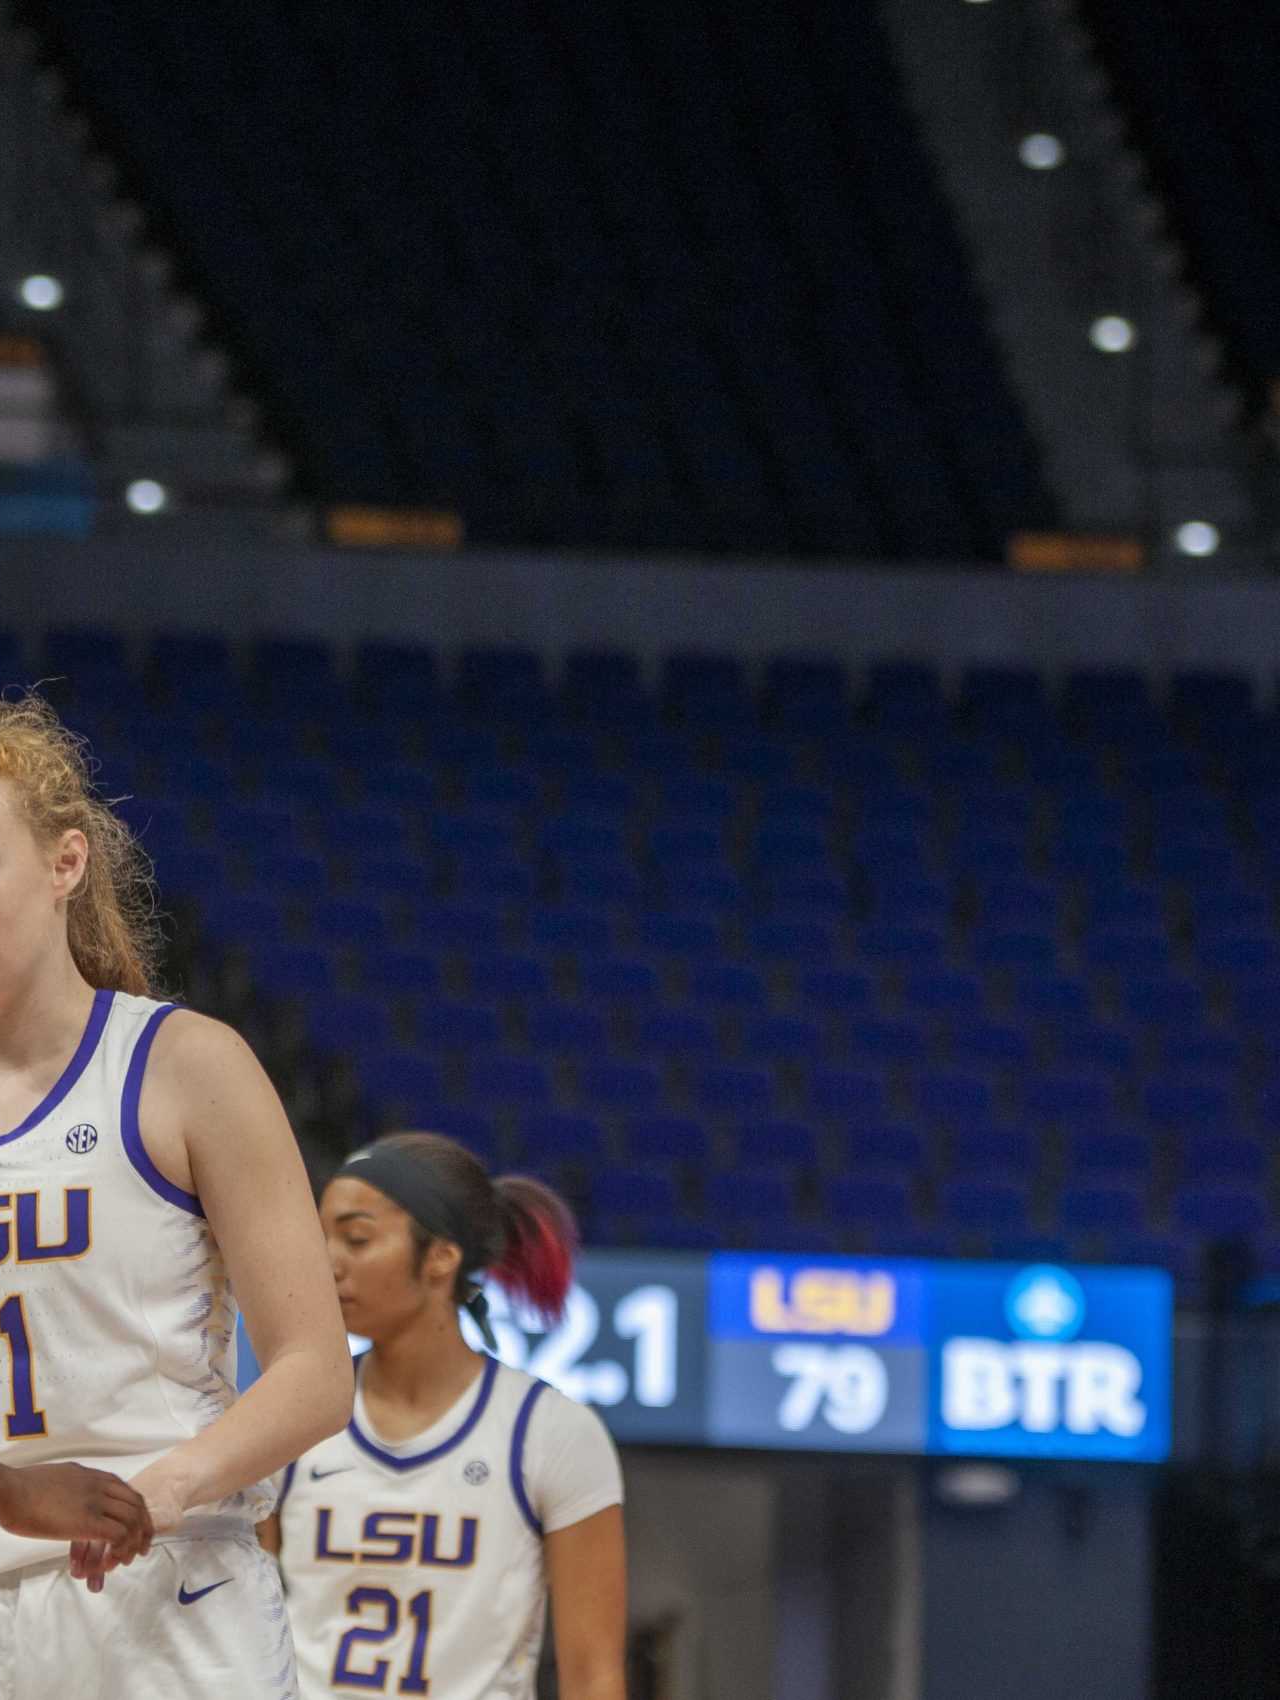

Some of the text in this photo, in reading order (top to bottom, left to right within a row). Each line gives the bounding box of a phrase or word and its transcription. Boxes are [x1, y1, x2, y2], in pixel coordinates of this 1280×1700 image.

[66, 1124, 98, 1154] SEC
[749, 1267, 897, 1337] LSU
[770, 1343, 889, 1434] 79
[941, 1335, 1147, 1437] BTR
[315, 1507, 480, 1570] LSU
[330, 1585, 435, 1697] 21
